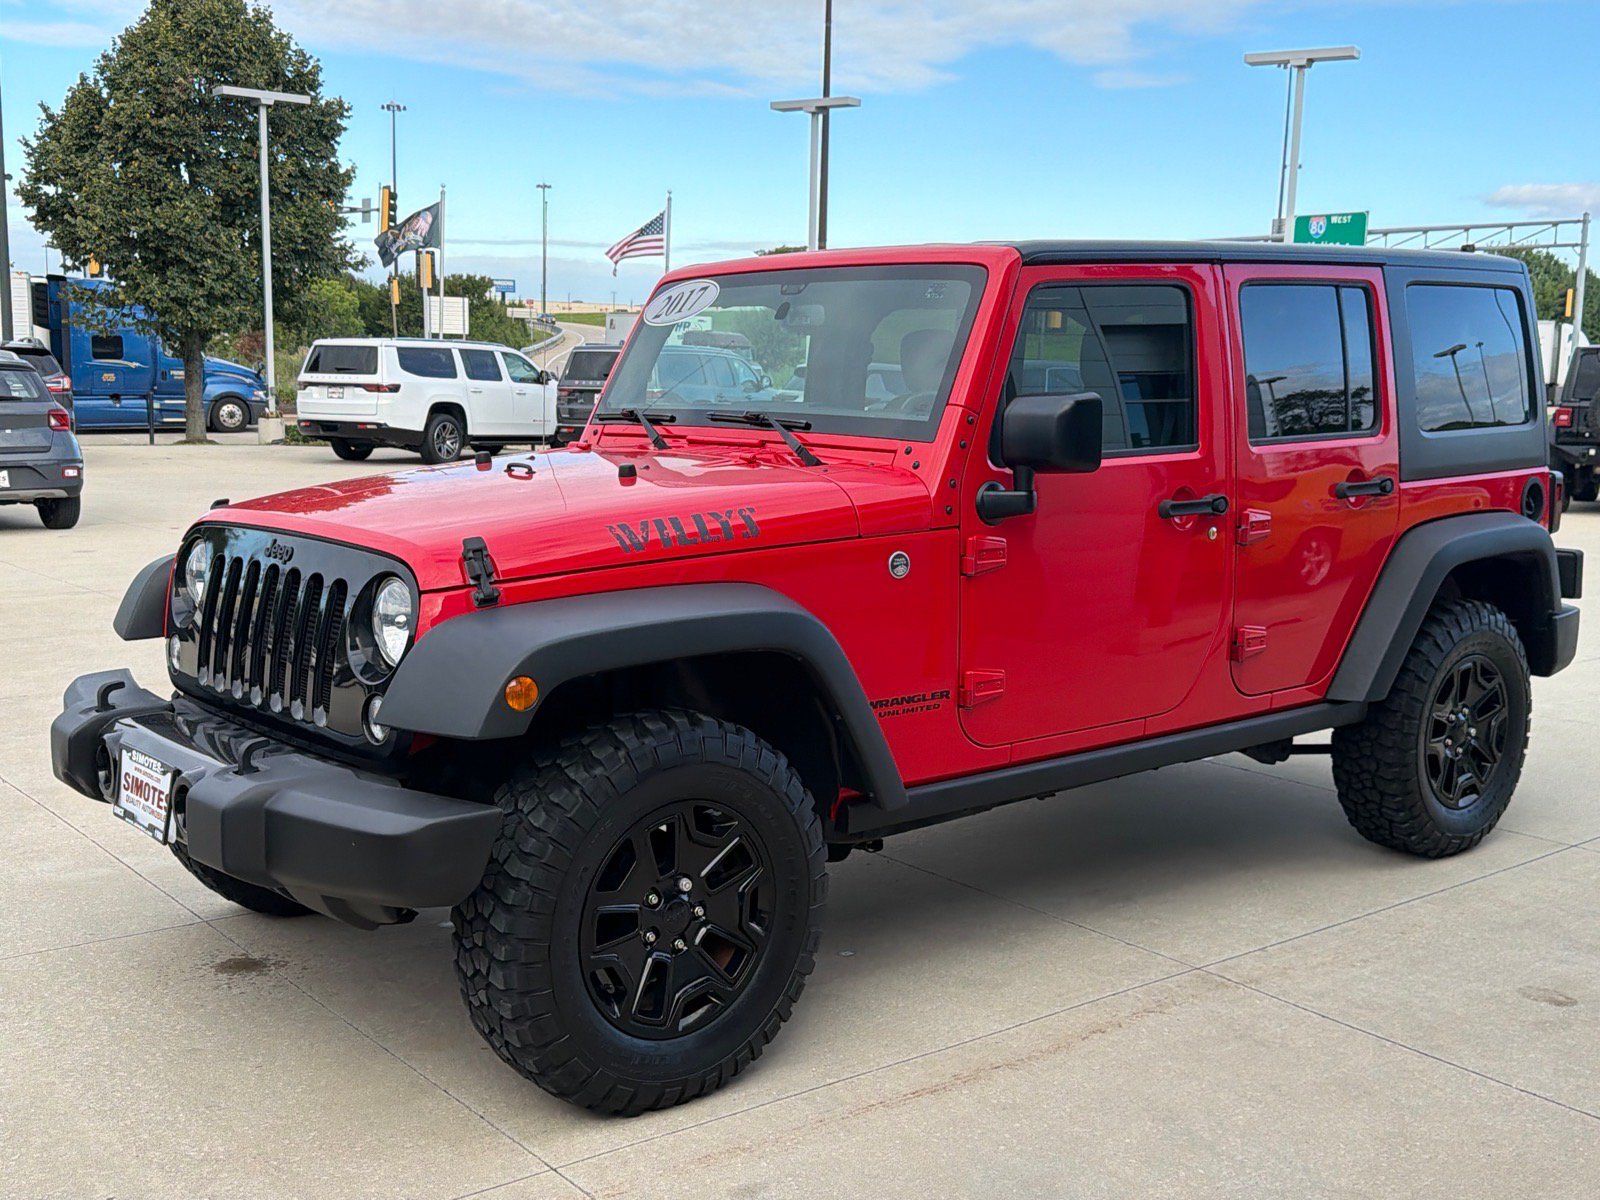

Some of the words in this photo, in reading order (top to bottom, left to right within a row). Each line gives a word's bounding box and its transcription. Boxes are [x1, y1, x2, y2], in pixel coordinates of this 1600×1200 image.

[1311, 221, 1325, 233] 80
[1331, 214, 1352, 224] WEST
[652, 285, 710, 319] 2017
[605, 507, 760, 553] WILLYS
[264, 538, 295, 565] Jeep
[879, 703, 941, 718] UNLIMITED
[131, 750, 164, 775] SIMOTES
